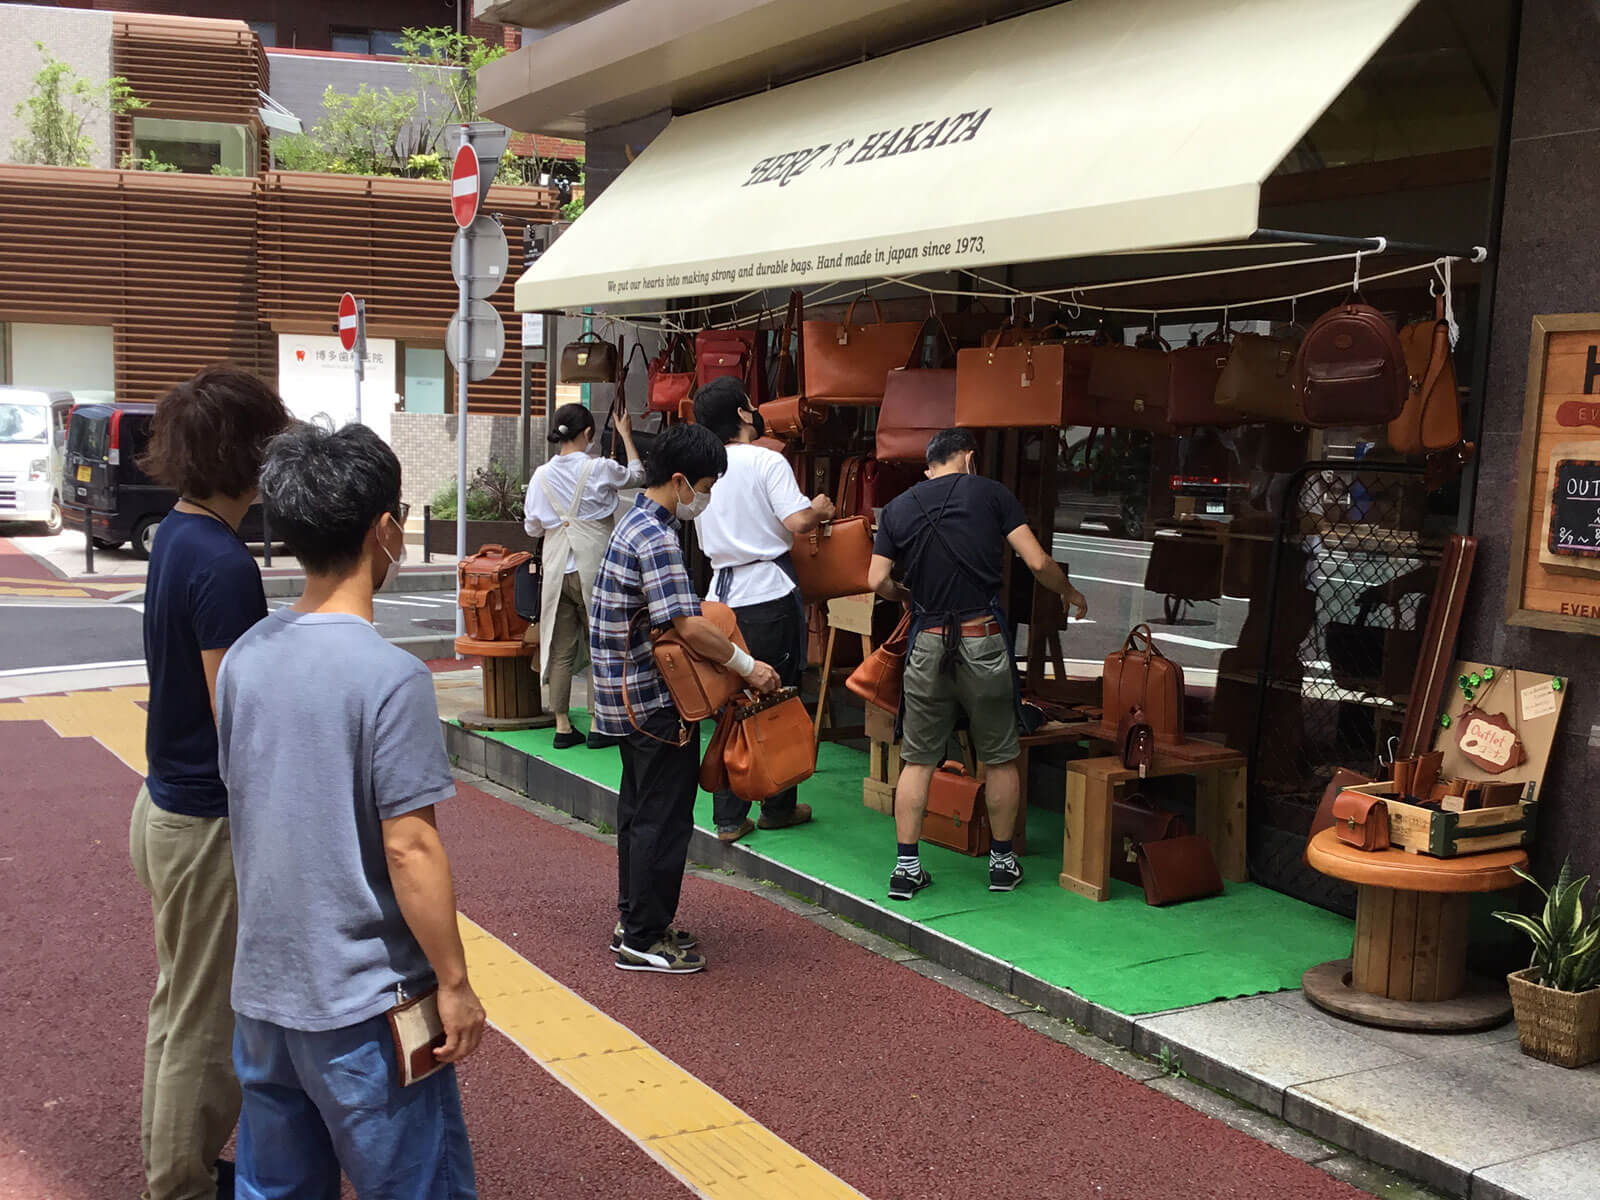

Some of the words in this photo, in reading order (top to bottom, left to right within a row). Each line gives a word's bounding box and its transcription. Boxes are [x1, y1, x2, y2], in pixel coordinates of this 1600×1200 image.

[741, 144, 832, 187] HERZ
[843, 107, 992, 166] HAKATA
[607, 281, 616, 292] We
[617, 282, 629, 295] put
[630, 281, 641, 290] our
[642, 277, 665, 289] hearts
[666, 274, 680, 287] into
[682, 271, 709, 286] making
[711, 268, 736, 283] strong
[738, 264, 754, 277] and
[756, 260, 788, 276] durable
[790, 258, 814, 275] bags.
[816, 253, 842, 270] Hand
[844, 249, 872, 266] made
[874, 252, 885, 262] in
[886, 246, 918, 265] japan
[921, 241, 951, 257] since
